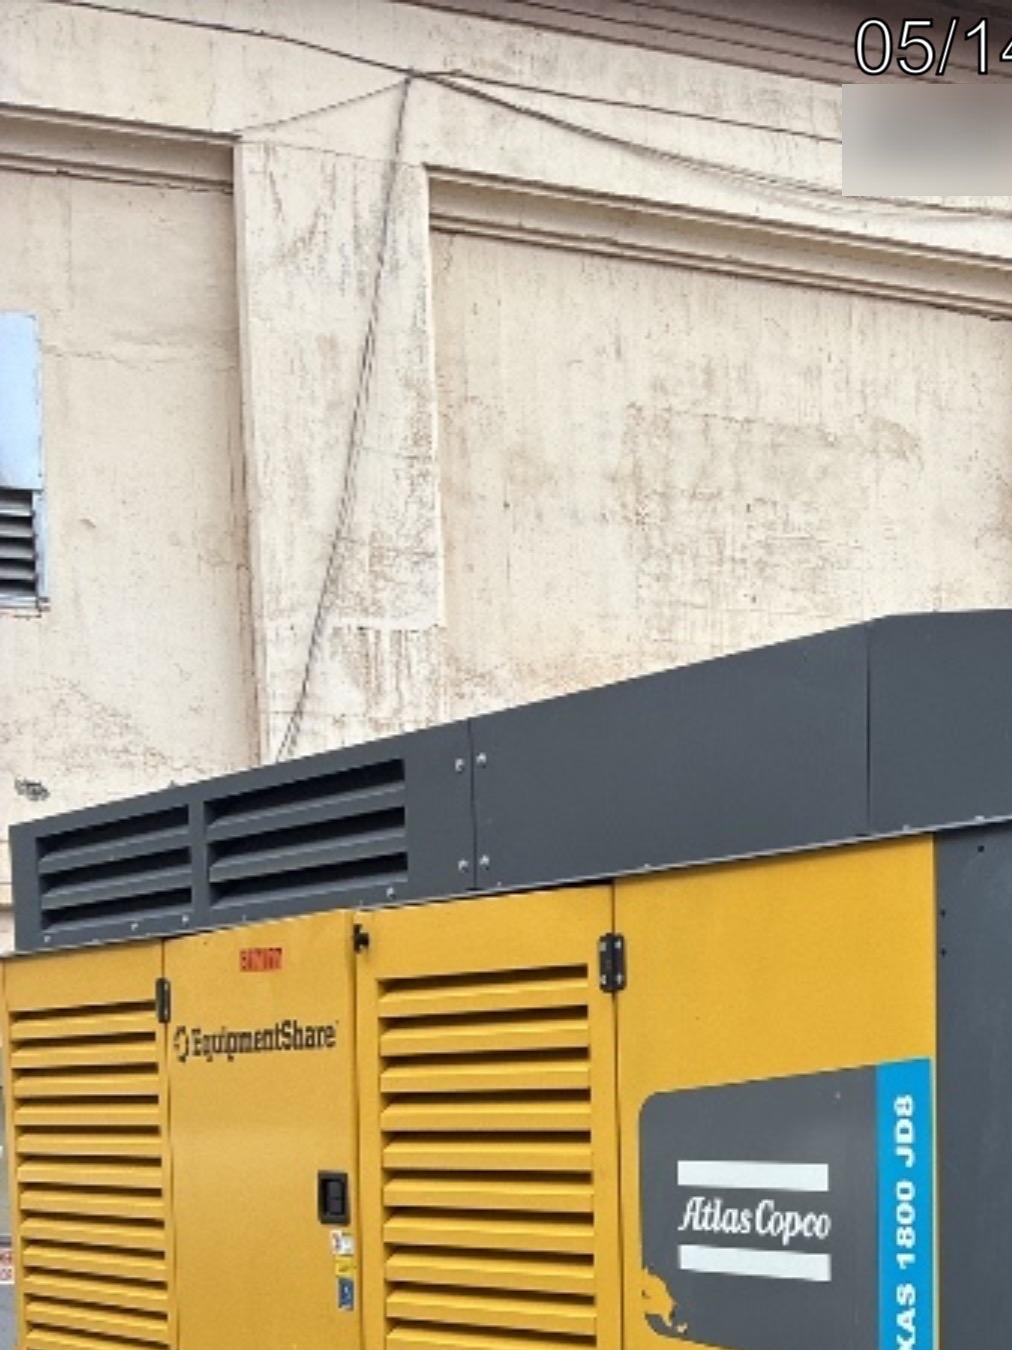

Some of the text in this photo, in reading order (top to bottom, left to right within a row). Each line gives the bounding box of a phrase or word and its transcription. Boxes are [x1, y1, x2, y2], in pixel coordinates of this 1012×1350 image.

[190, 1018, 337, 1063] EquipmentShare
[893, 1094, 915, 1168] JD8
[677, 1195, 832, 1246] Atlas Copco
[895, 1180, 916, 1270] 1800
